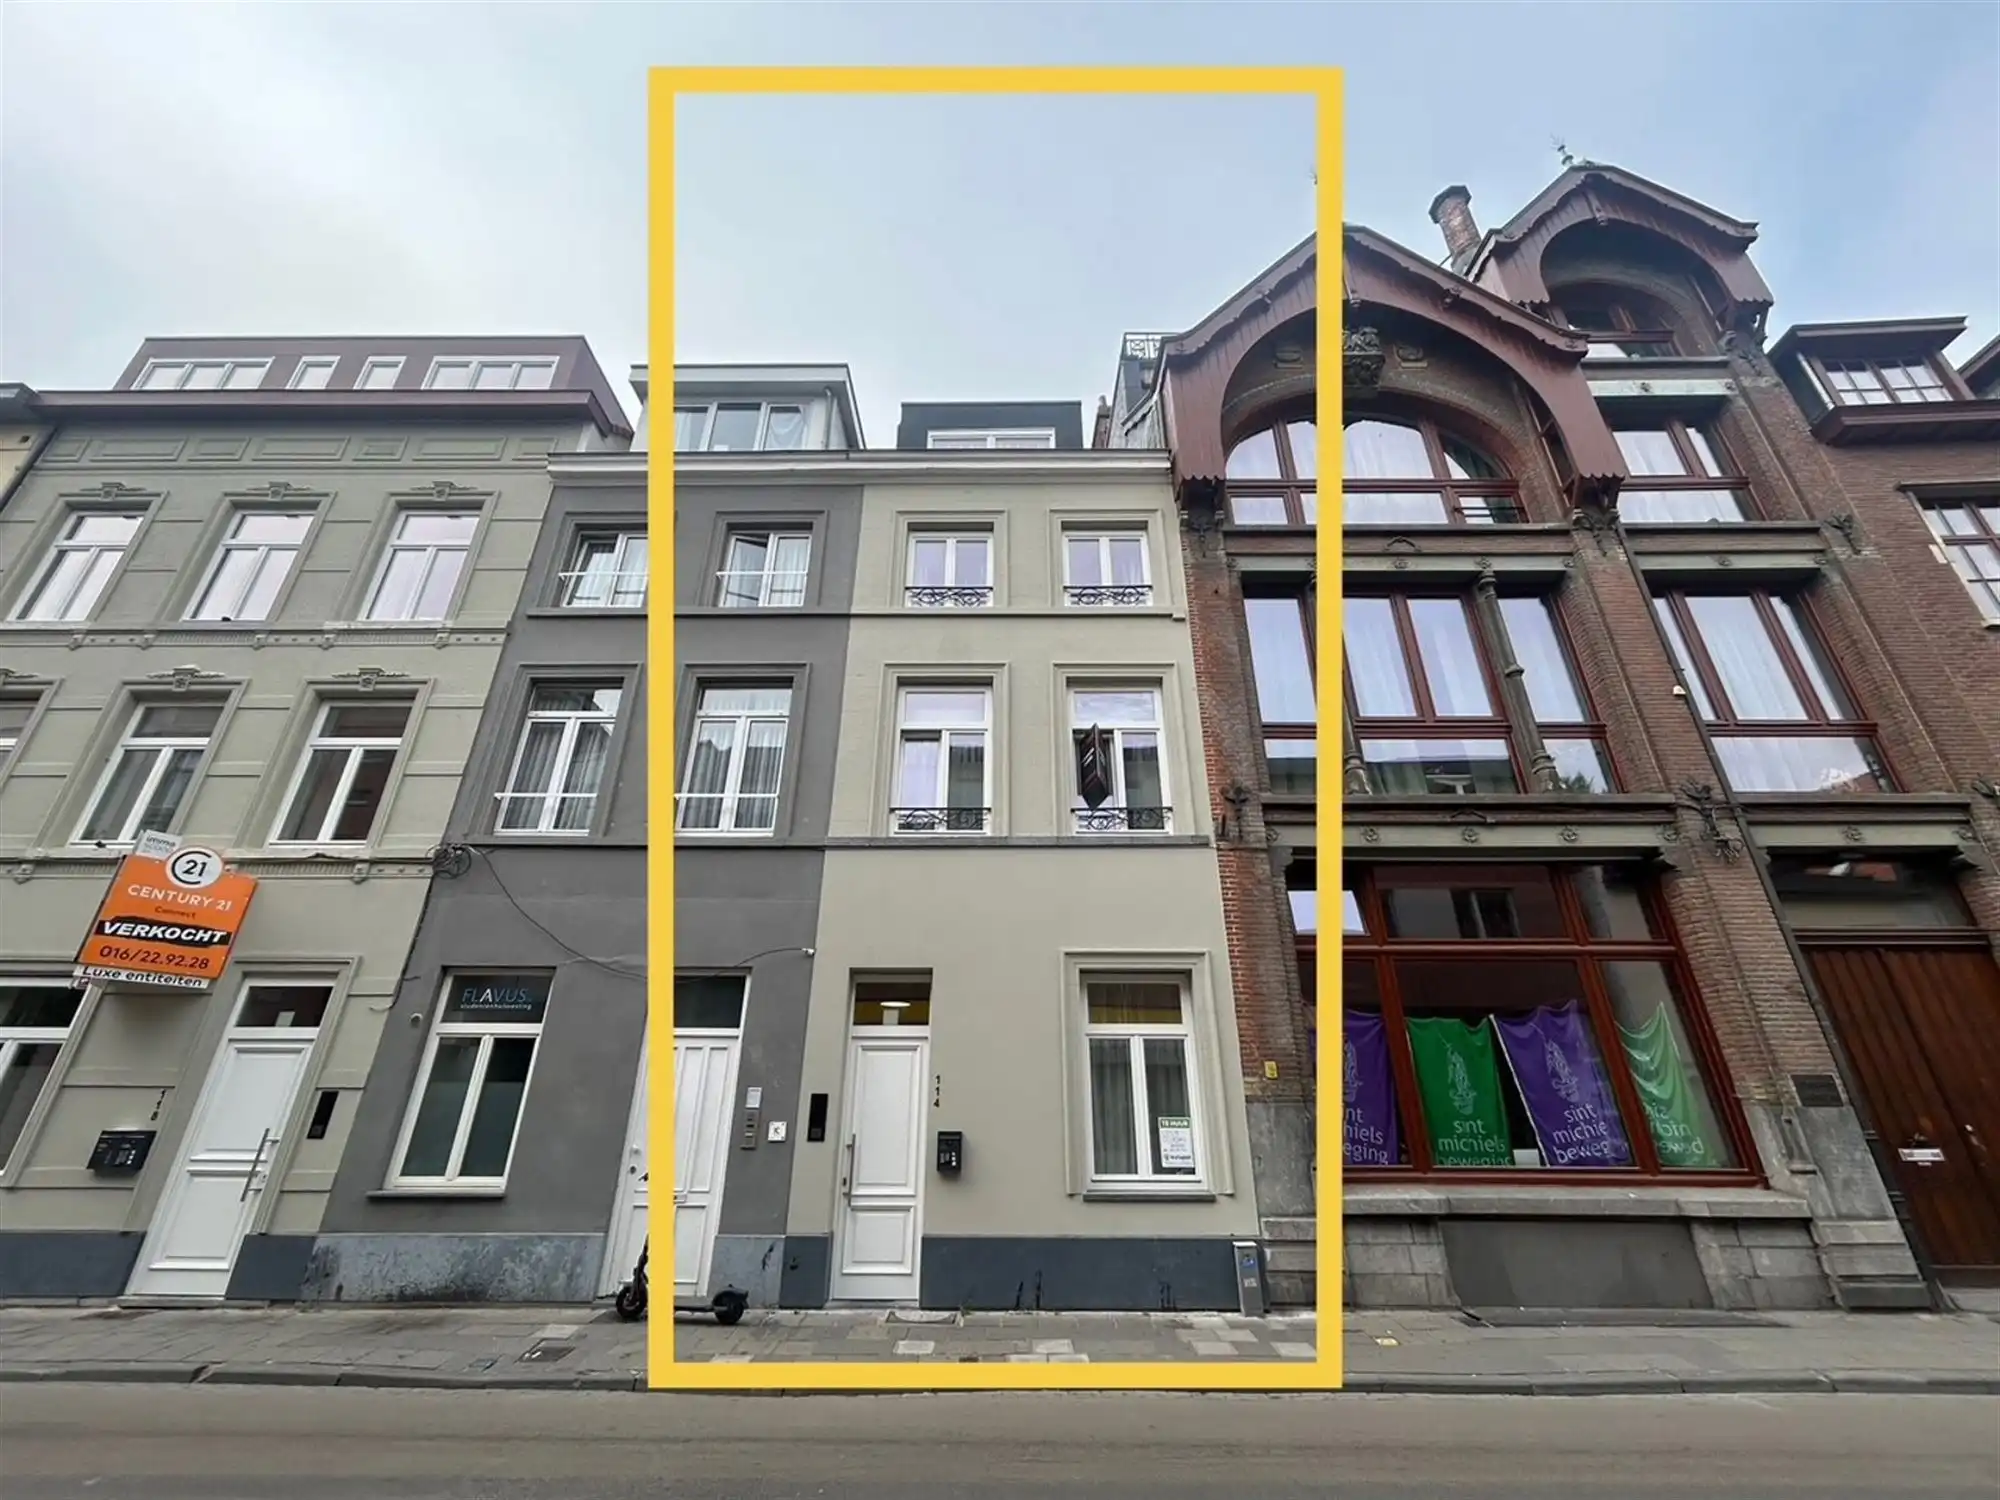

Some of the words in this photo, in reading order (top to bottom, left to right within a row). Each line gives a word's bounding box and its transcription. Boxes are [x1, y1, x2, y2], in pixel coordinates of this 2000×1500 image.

[128, 884, 213, 908] CENTURY
[216, 899, 232, 911] 21
[155, 906, 197, 919] Connect
[104, 921, 228, 943] VERKOCHT
[100, 945, 210, 970] 016/22.92.28
[83, 966, 121, 979] Luxe
[126, 971, 202, 987] entiteiten
[462, 987, 528, 1003] FLAVUS
[933, 1074, 941, 1108] 114
[1346, 1108, 1364, 1123] nt
[1564, 1103, 1597, 1123] sint
[1343, 1121, 1384, 1145] hiels
[1553, 1119, 1608, 1144] michie
[1343, 1142, 1389, 1165] eging
[1553, 1141, 1610, 1164] beweg
